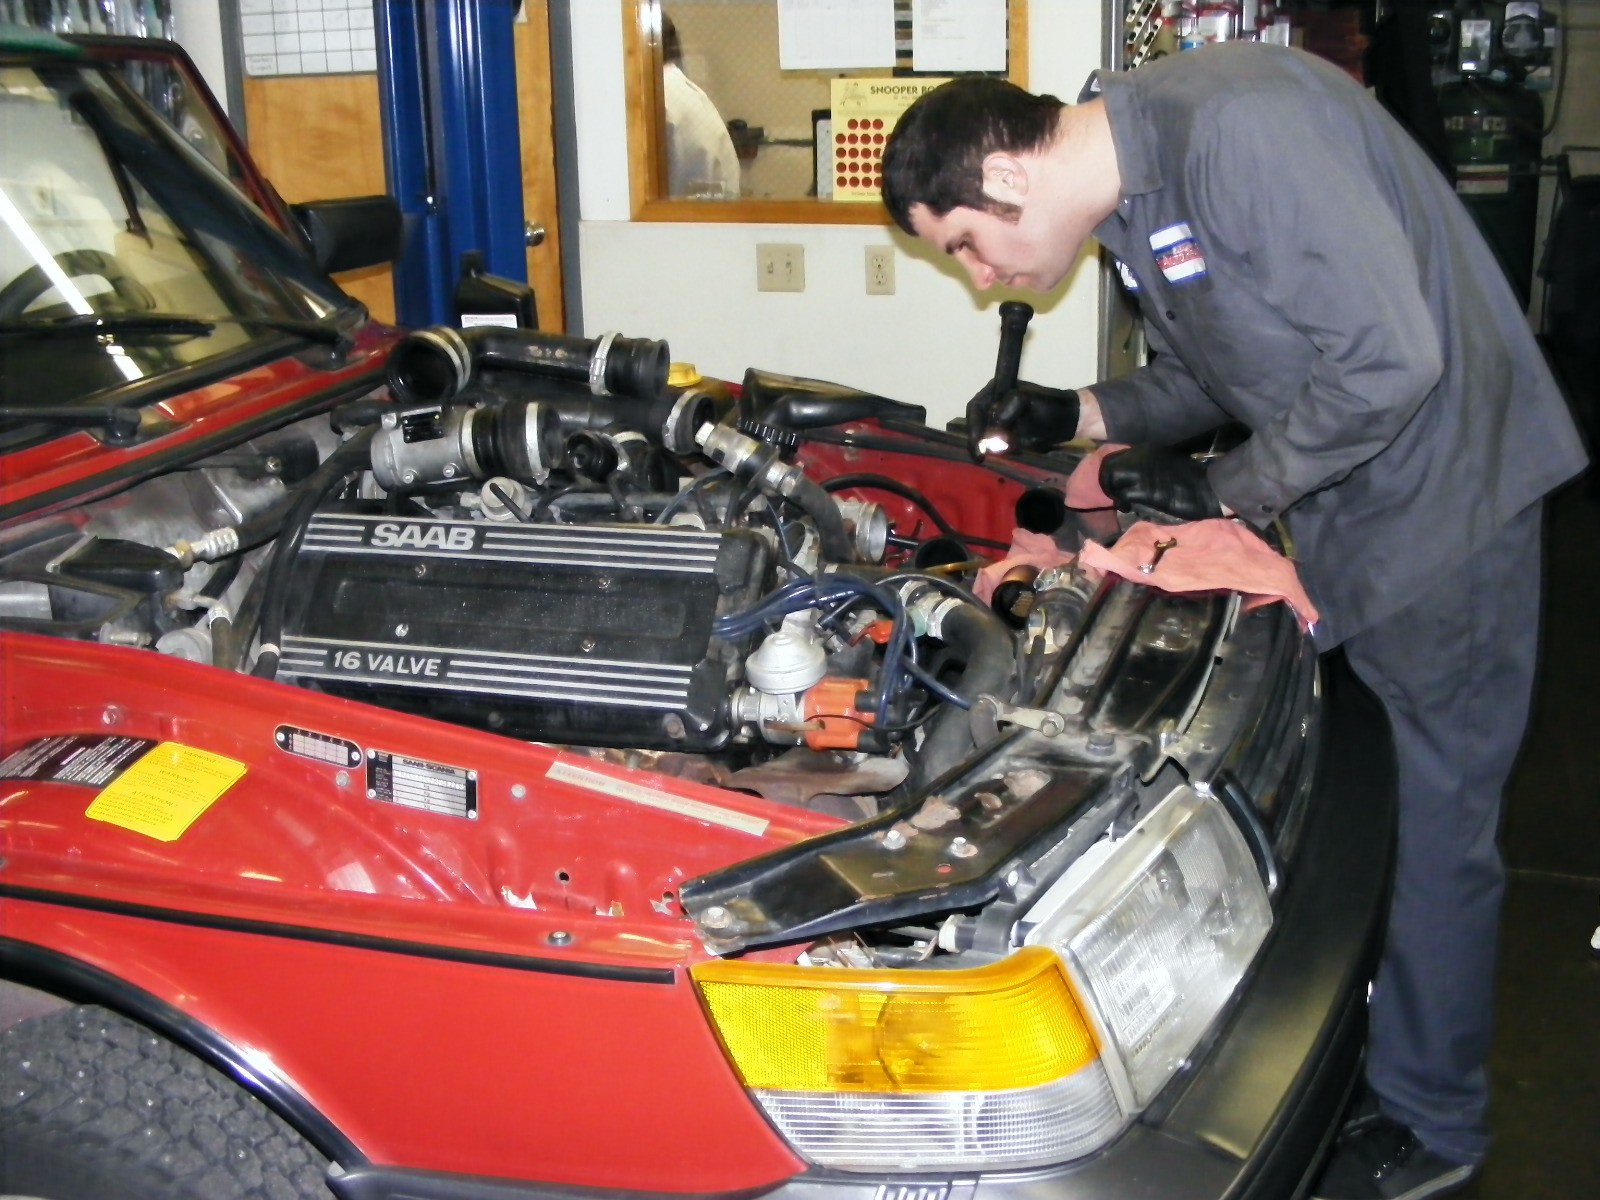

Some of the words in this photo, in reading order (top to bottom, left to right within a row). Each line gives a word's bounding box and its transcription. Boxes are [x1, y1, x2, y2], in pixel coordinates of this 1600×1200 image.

[870, 85, 918, 95] SNOOPER
[921, 85, 936, 95] BO
[371, 523, 476, 551] SAAB
[334, 651, 362, 670] 16
[368, 653, 442, 677] VALVE
